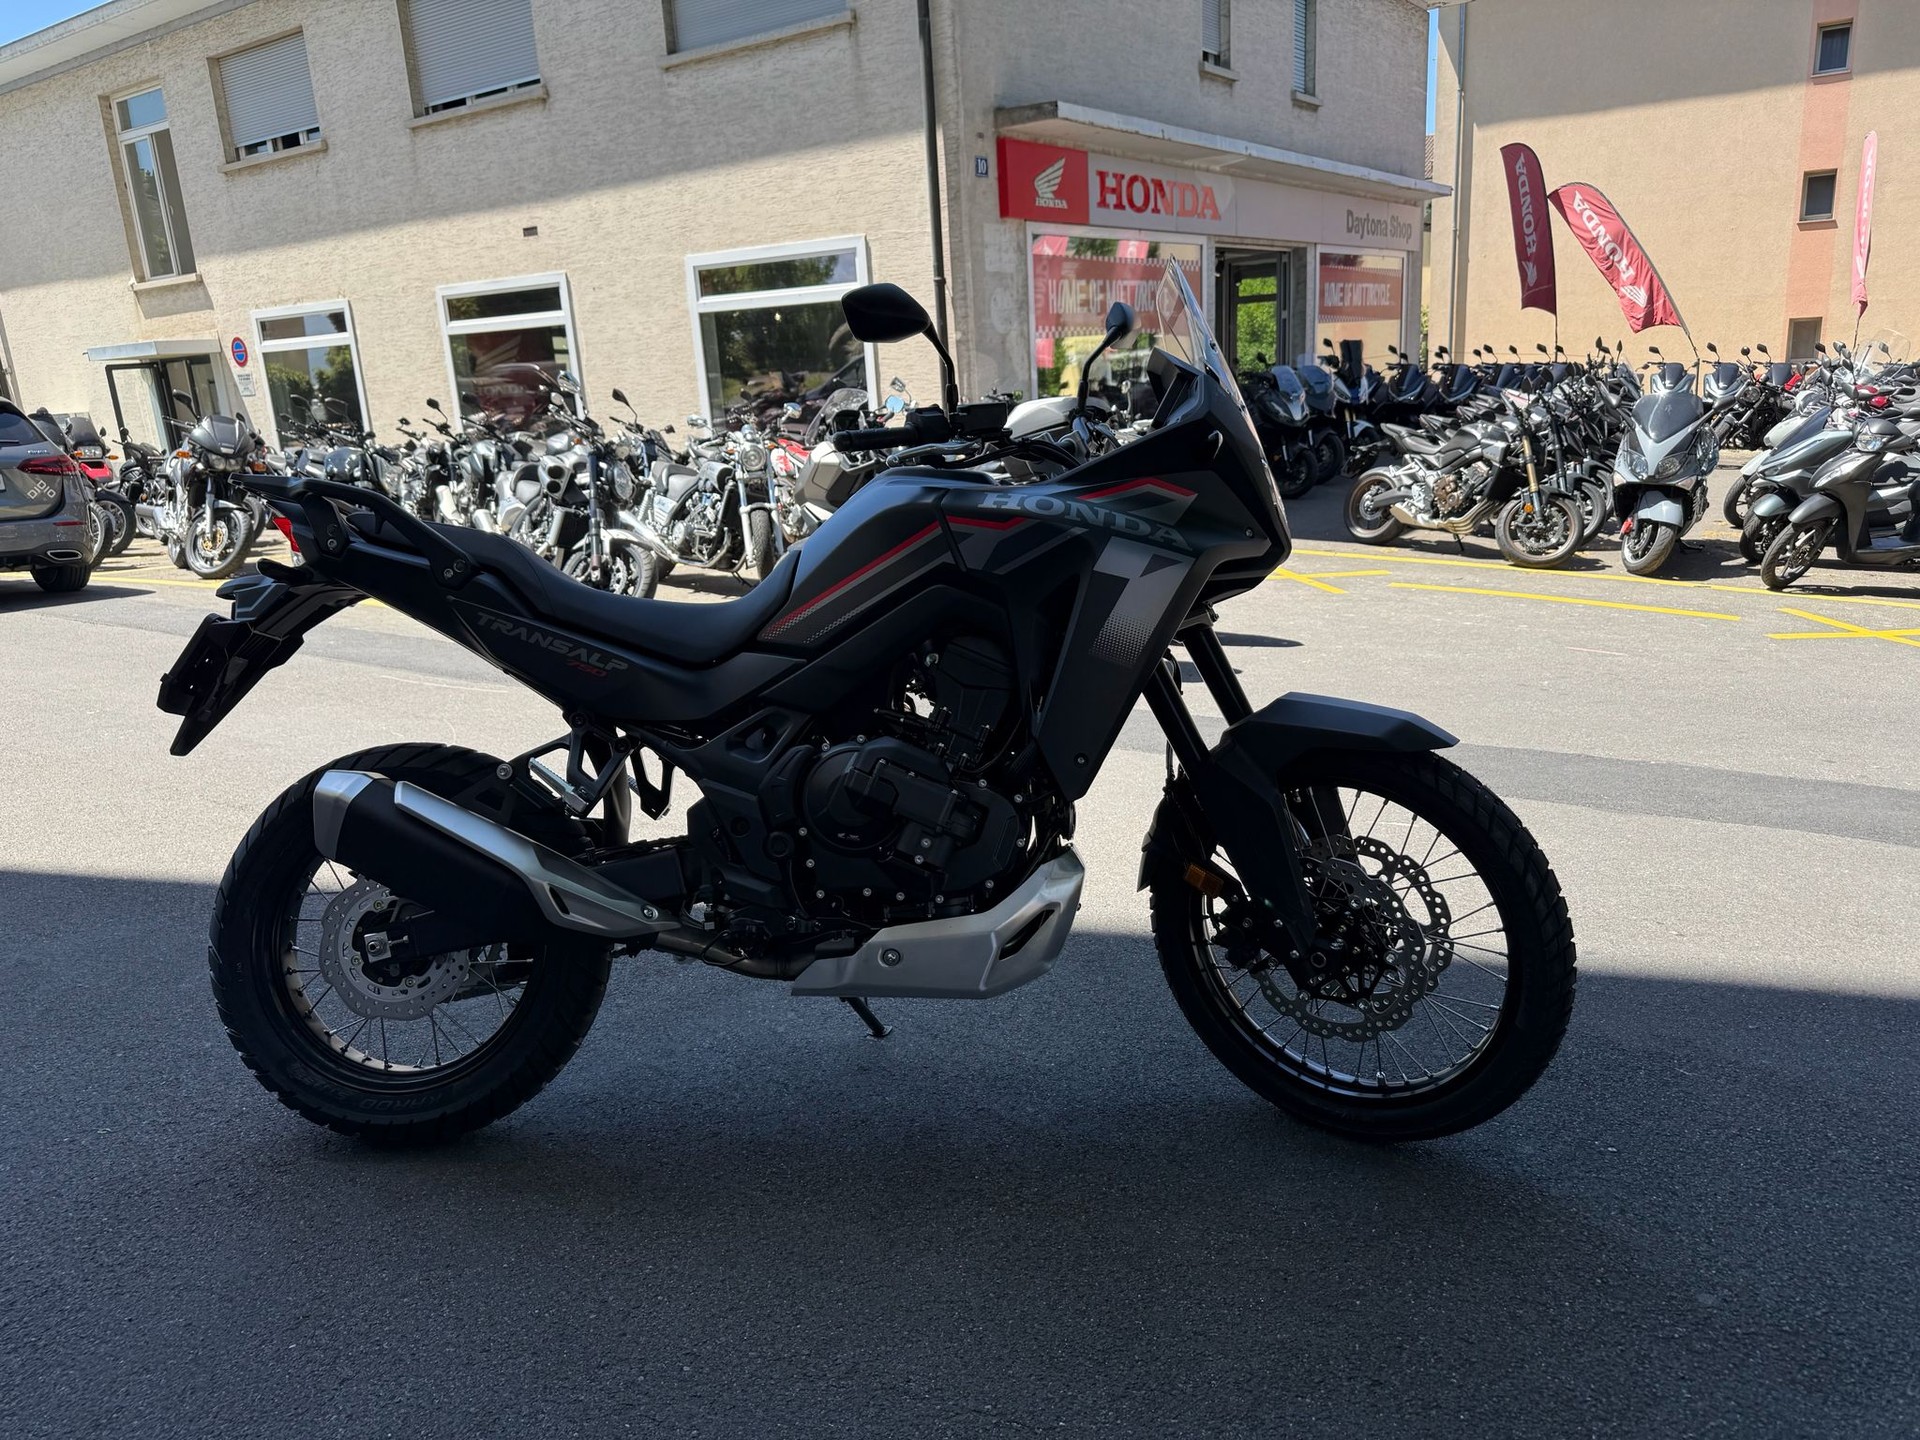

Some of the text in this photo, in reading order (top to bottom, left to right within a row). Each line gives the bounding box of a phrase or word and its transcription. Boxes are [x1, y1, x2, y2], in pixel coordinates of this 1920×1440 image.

[977, 158, 987, 174] 10
[1035, 197, 1068, 209] HONDA
[1096, 170, 1221, 221] HONDA
[1515, 153, 1536, 256] HONDA
[1346, 209, 1412, 243] Daytona Shop
[1573, 190, 1635, 281] HONDA
[1048, 279, 1087, 314] HOME
[1089, 279, 1105, 313] OF
[978, 492, 1193, 551] HONDA
[477, 612, 629, 671] TRANSALP
[565, 659, 609, 678] 750
